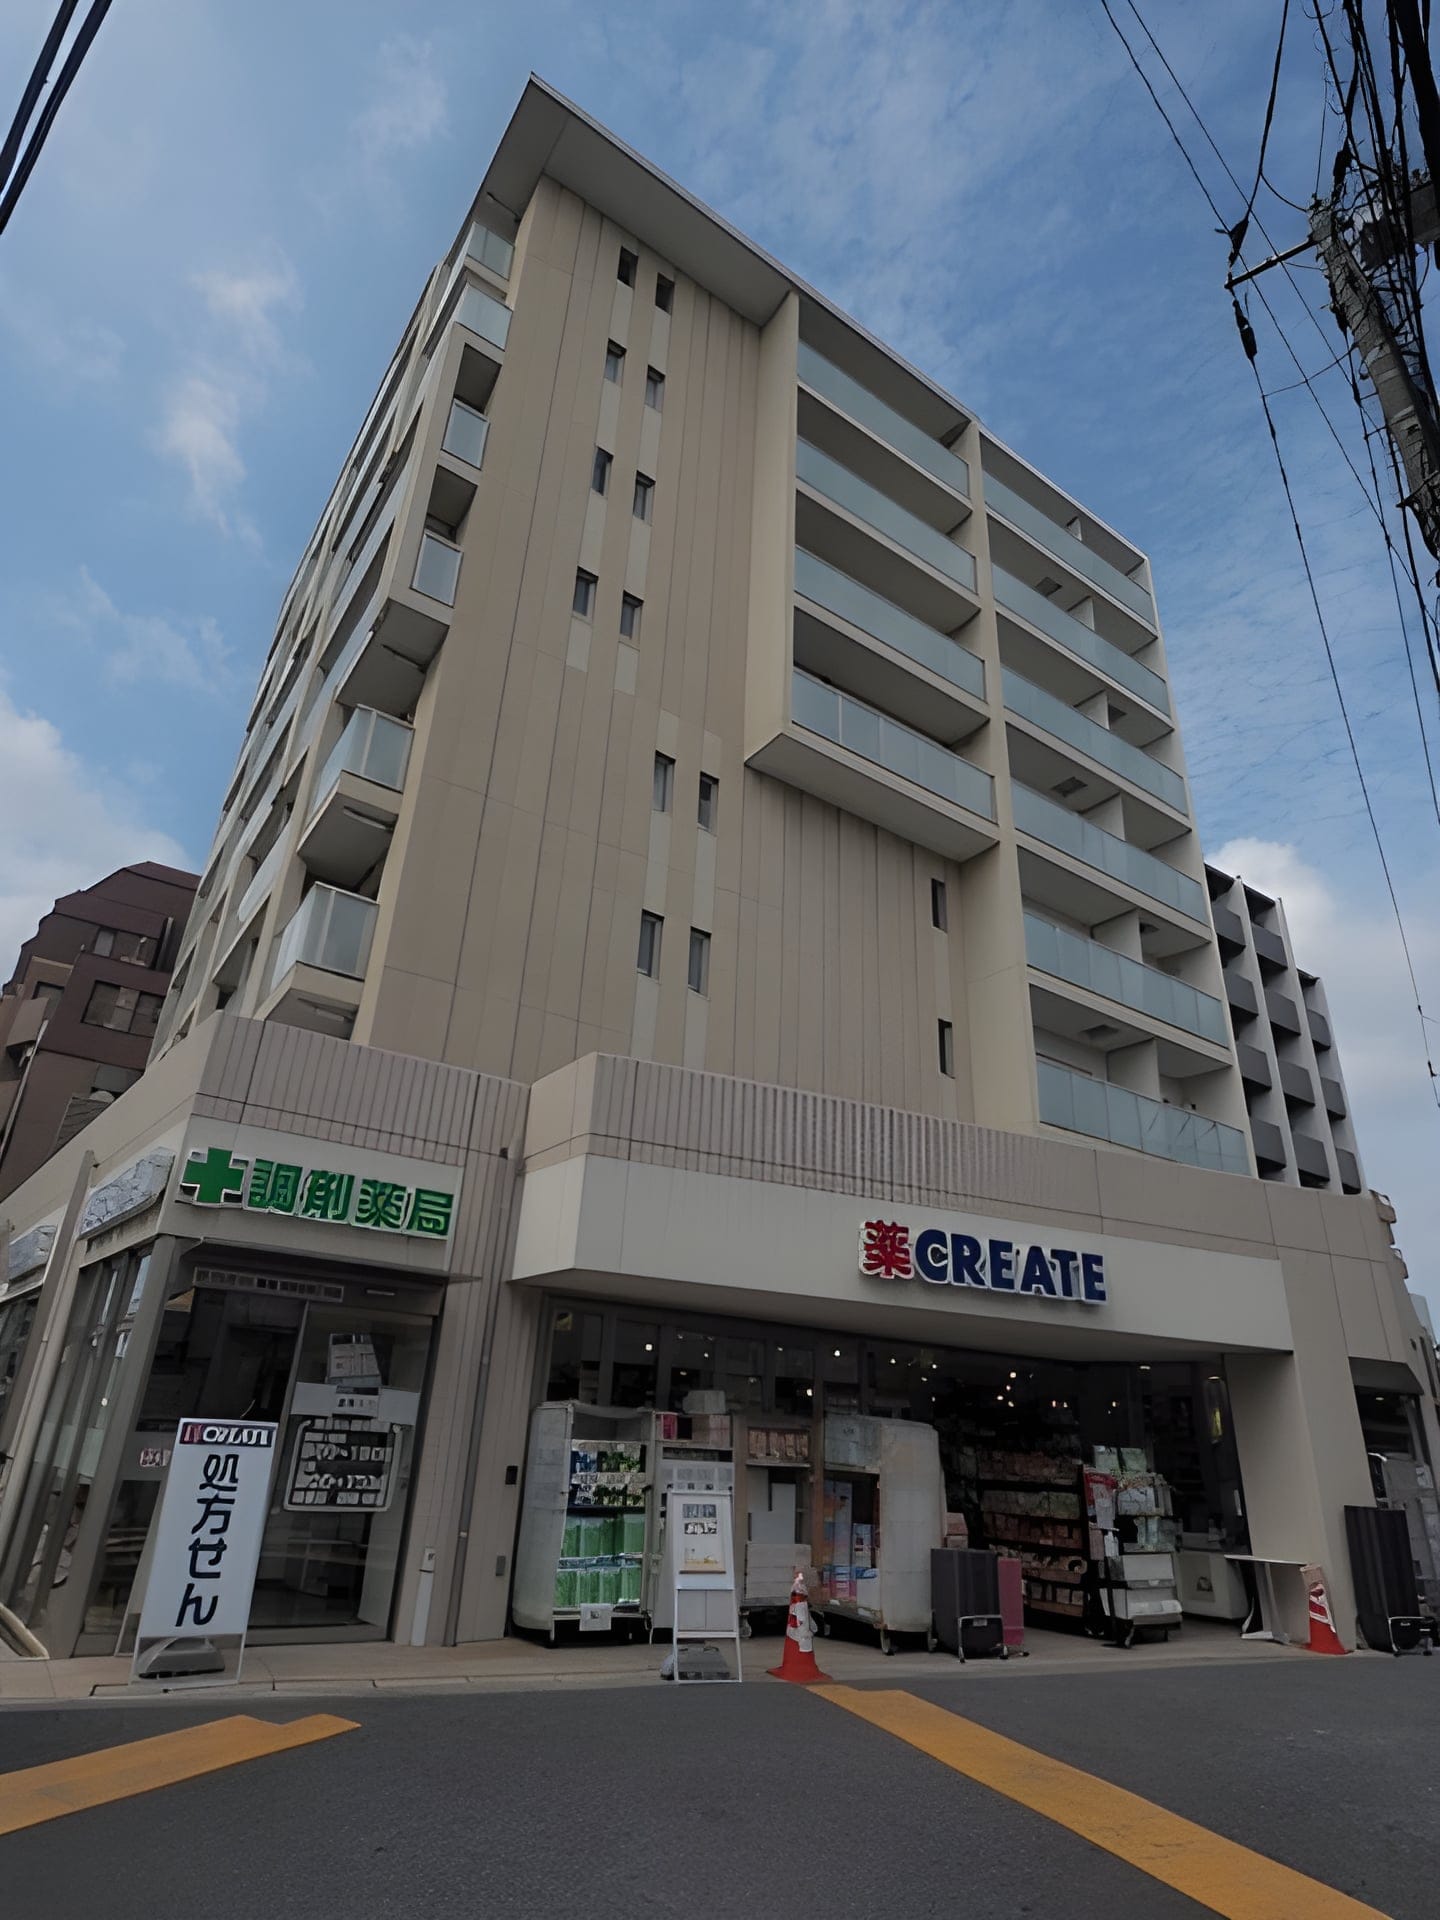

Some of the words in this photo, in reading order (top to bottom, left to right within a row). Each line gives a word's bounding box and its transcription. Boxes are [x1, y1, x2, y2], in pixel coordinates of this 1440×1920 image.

[863, 1220, 913, 1278] 薬
[915, 1229, 1107, 1301] CREATE
[175, 1454, 239, 1627] 処方せん
